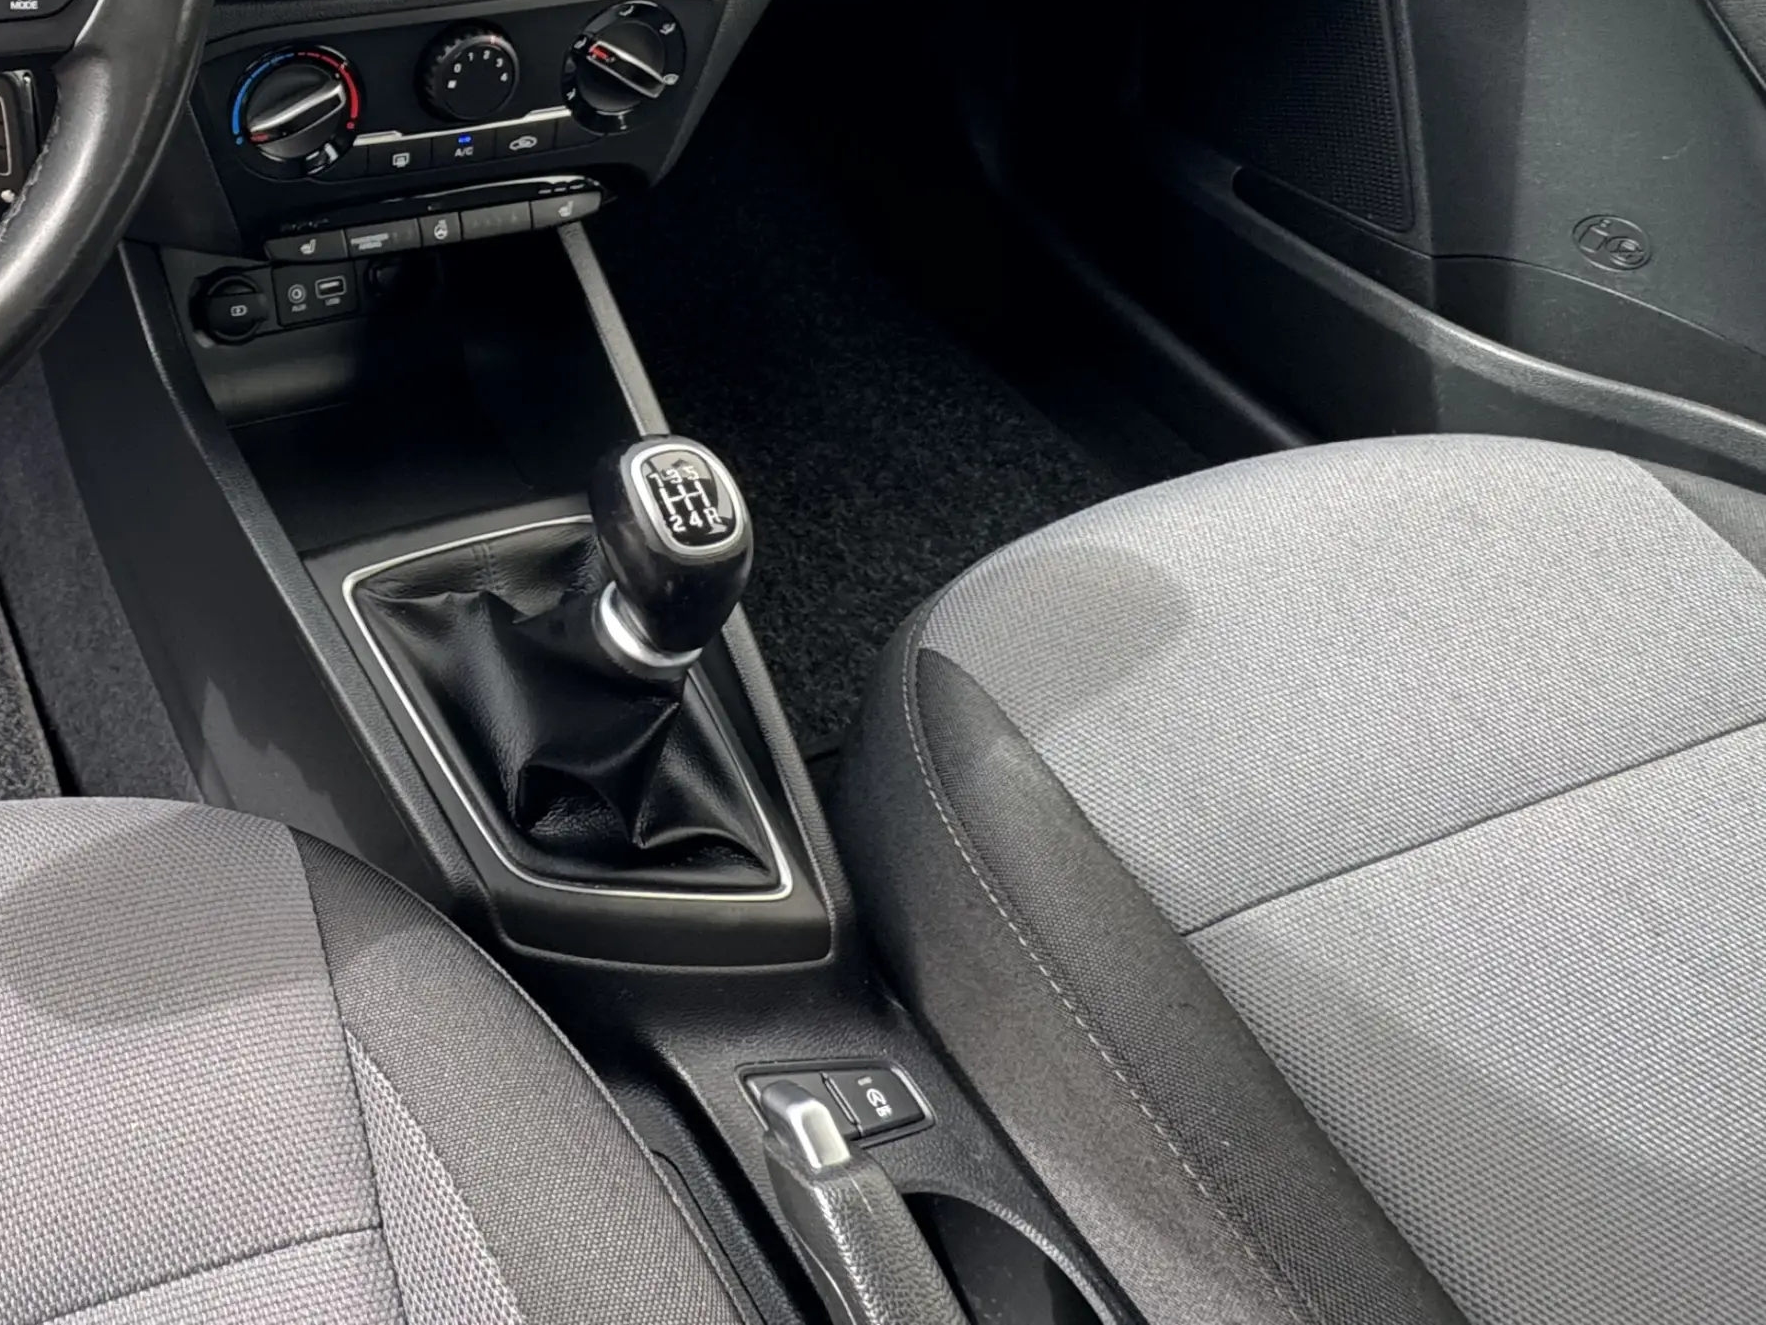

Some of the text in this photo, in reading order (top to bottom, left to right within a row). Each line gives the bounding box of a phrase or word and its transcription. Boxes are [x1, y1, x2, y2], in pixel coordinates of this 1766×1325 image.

[10, 0, 38, 10] MODE
[666, 469, 682, 484] 3
[669, 514, 686, 532] 2
[689, 510, 703, 527] 4
